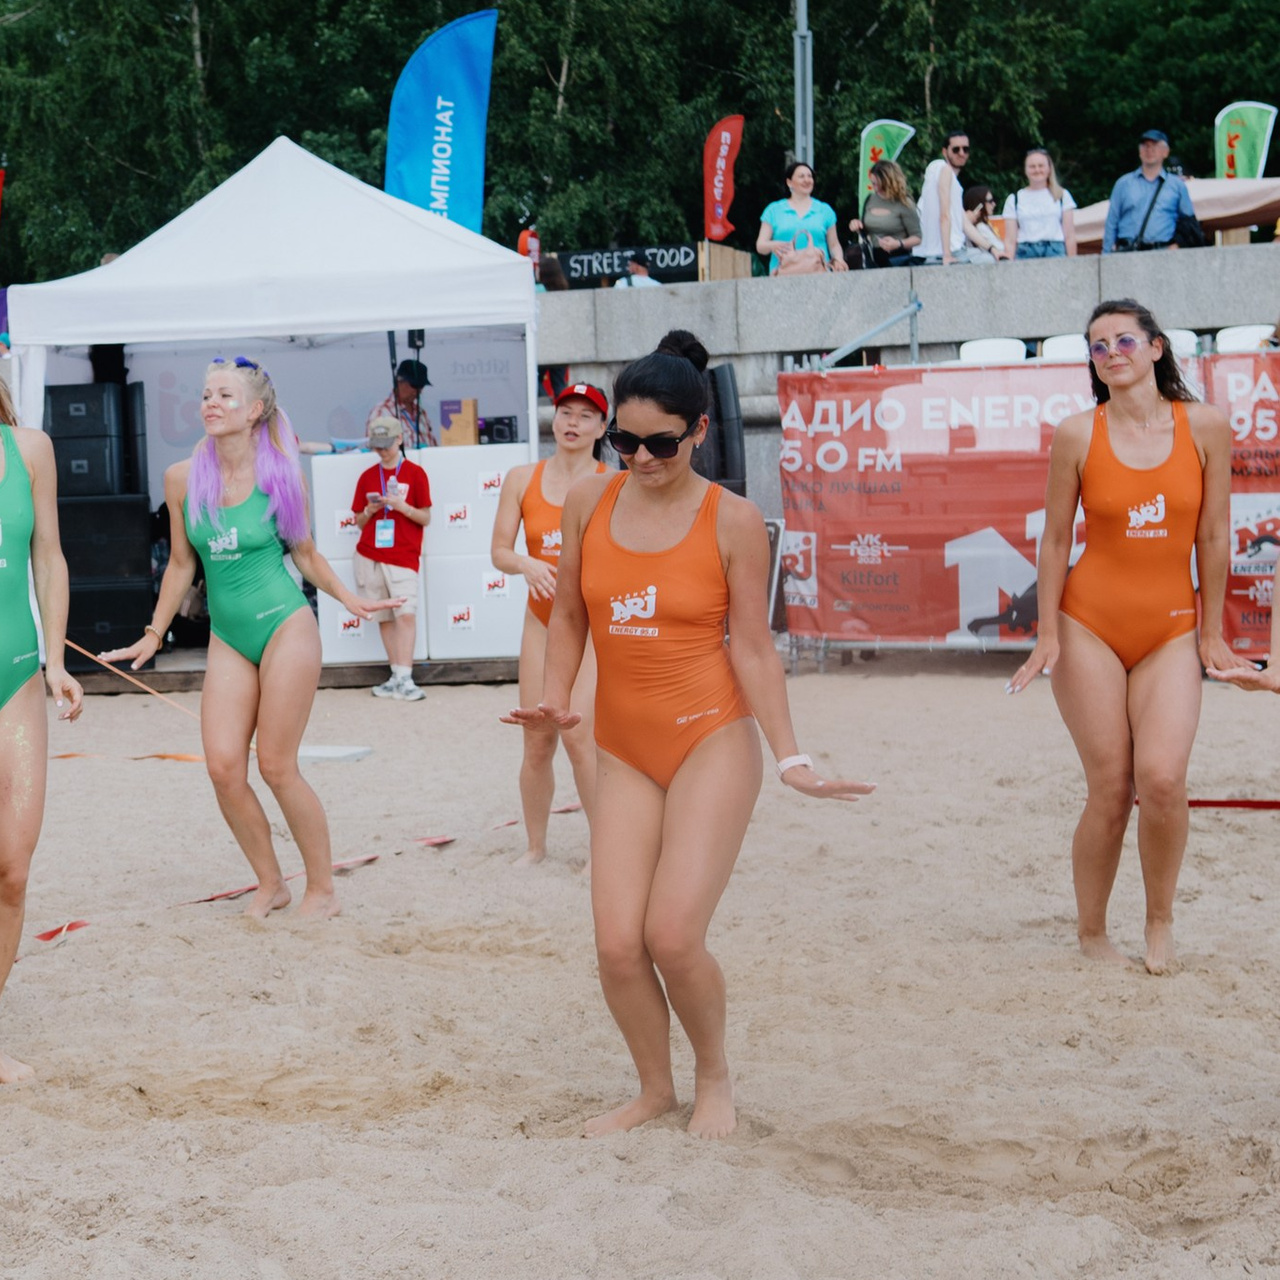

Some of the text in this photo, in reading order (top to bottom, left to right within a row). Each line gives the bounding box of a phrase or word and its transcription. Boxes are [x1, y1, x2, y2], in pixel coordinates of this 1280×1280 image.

[780, 440, 903, 473] 5.0 FM
[857, 534, 881, 545] VK
[849, 540, 891, 557] fest
[841, 570, 899, 586] Kitfort
[610, 626, 657, 636] ENERGY 95.0
